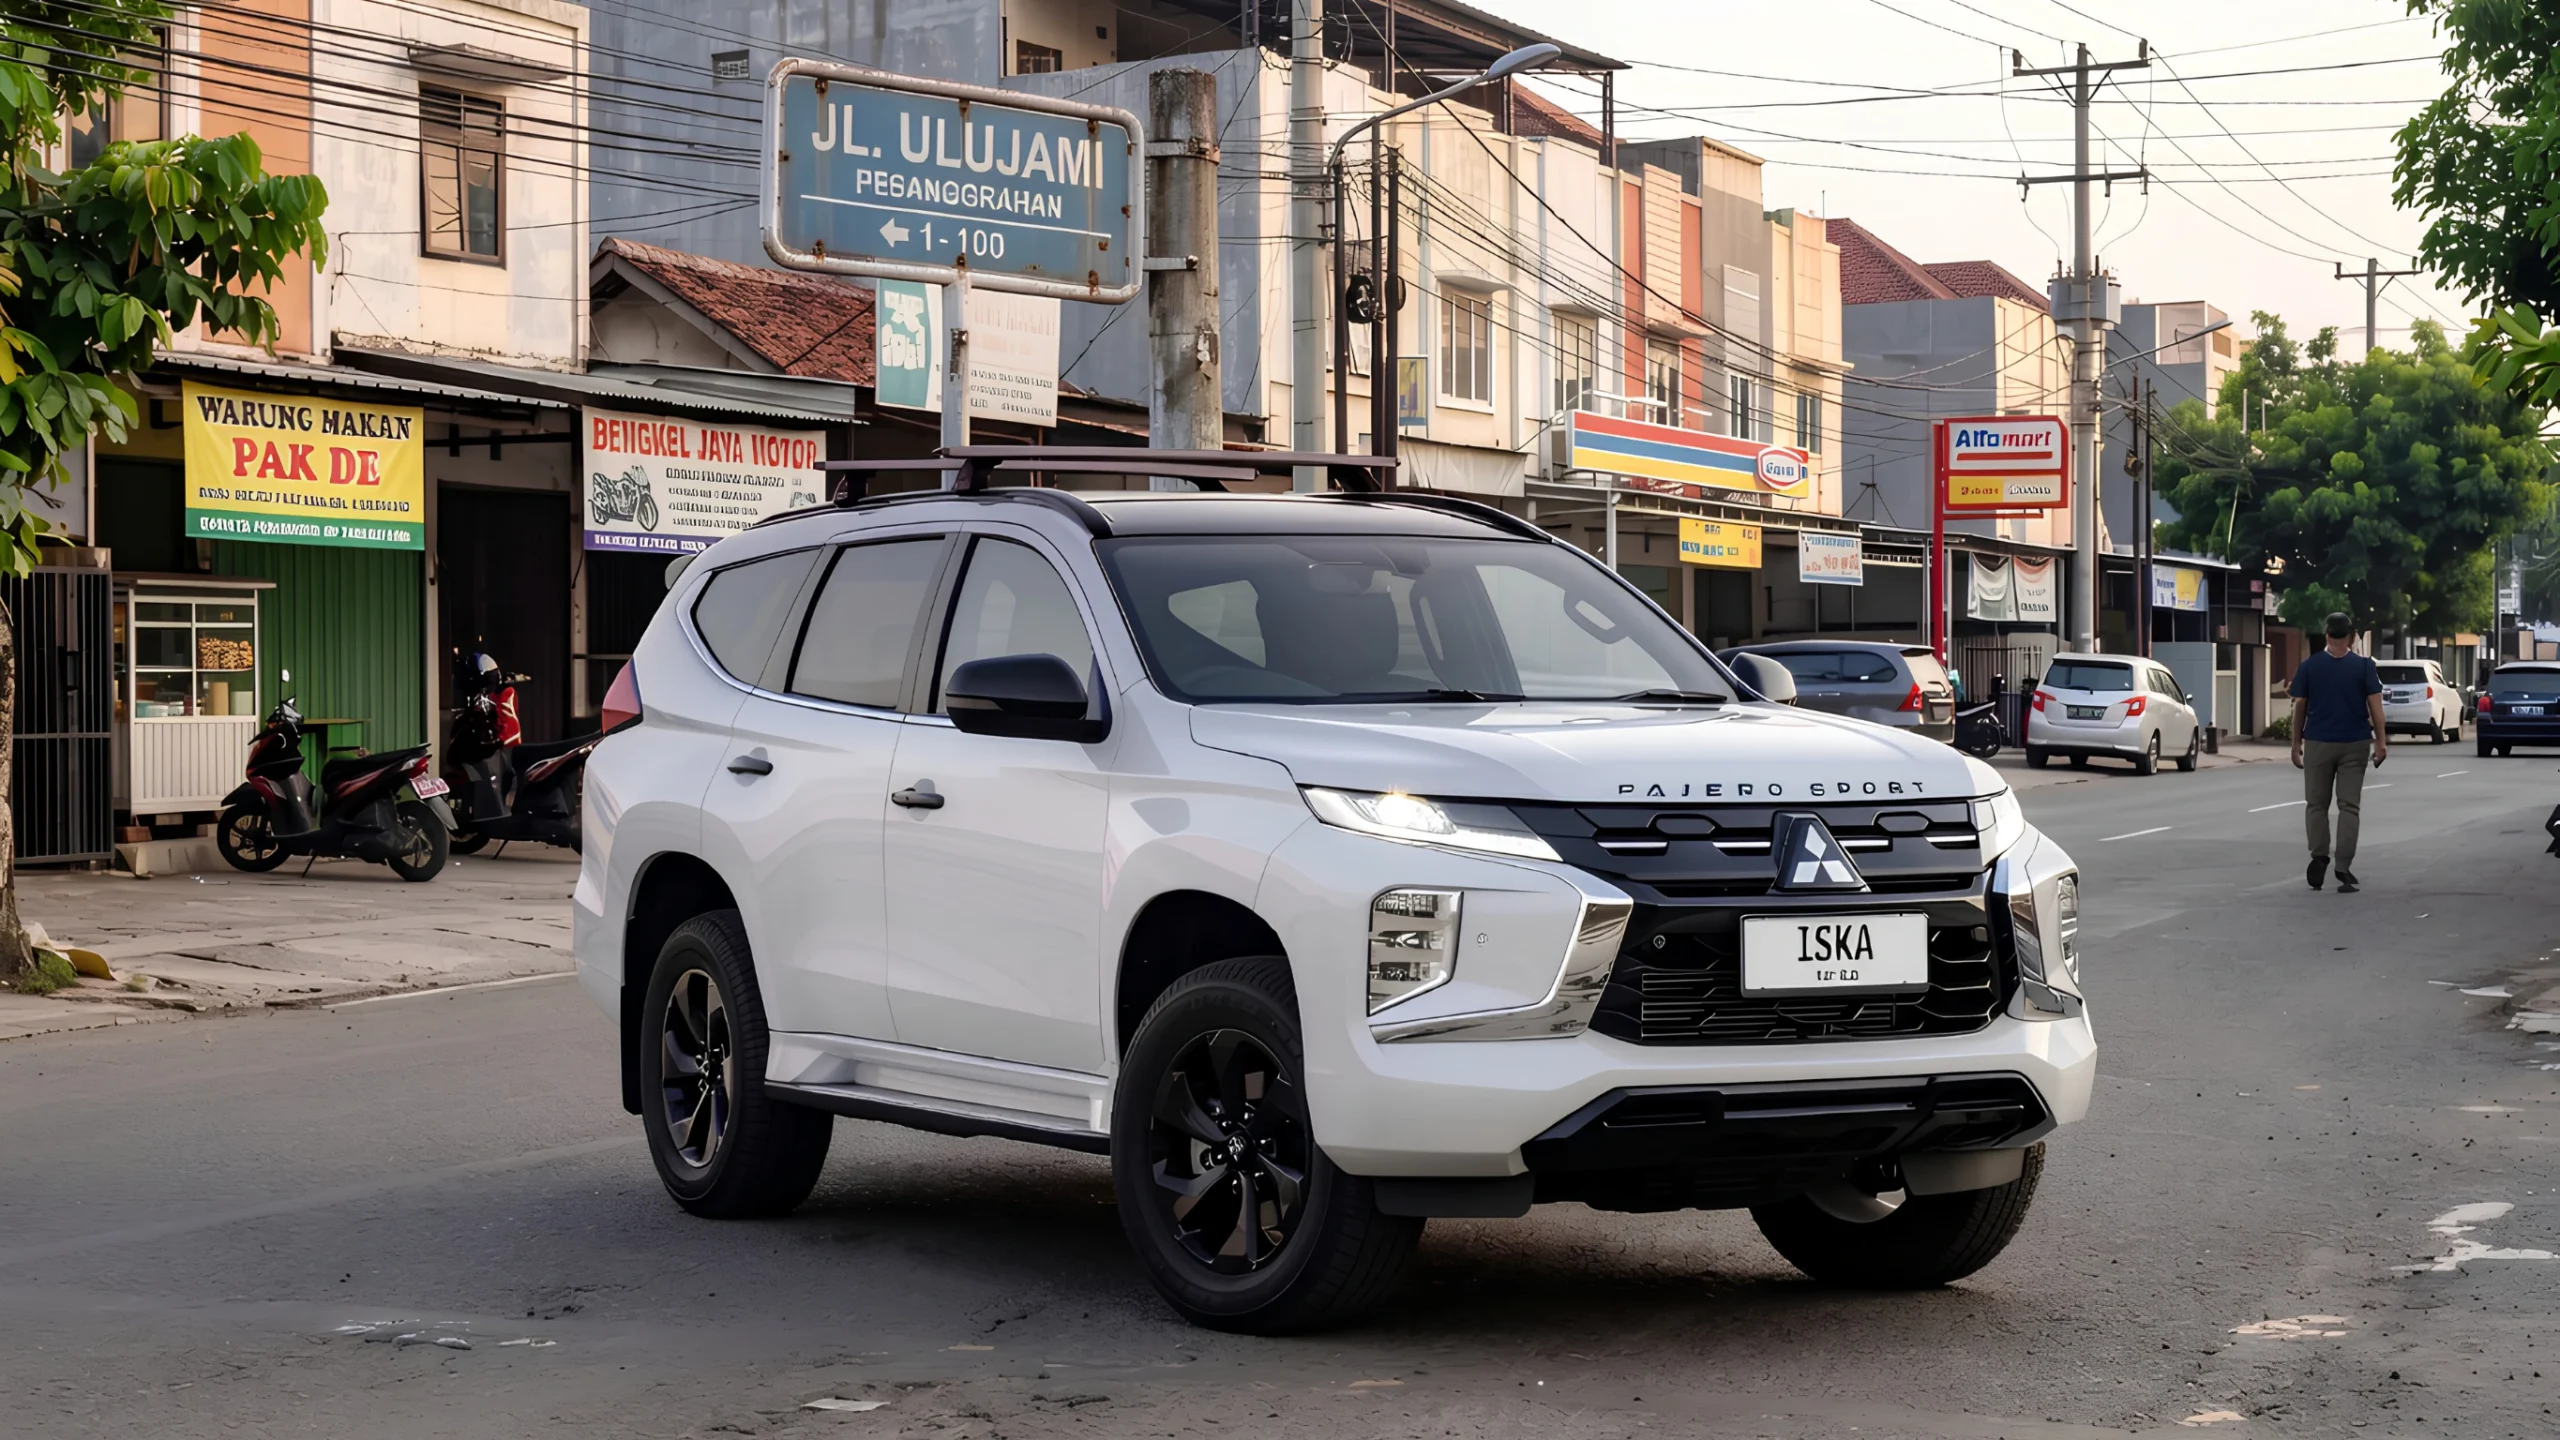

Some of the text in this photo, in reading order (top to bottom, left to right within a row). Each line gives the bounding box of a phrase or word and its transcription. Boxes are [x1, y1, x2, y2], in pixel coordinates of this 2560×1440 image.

[811, 103, 1104, 190] JL. ULUJAMI
[196, 395, 313, 432] WARUNG
[232, 437, 381, 486] PAK DE
[697, 428, 744, 464] JAYA
[1618, 781, 1925, 797] PAJERO SPORT
[1797, 923, 1874, 962] ISKA
